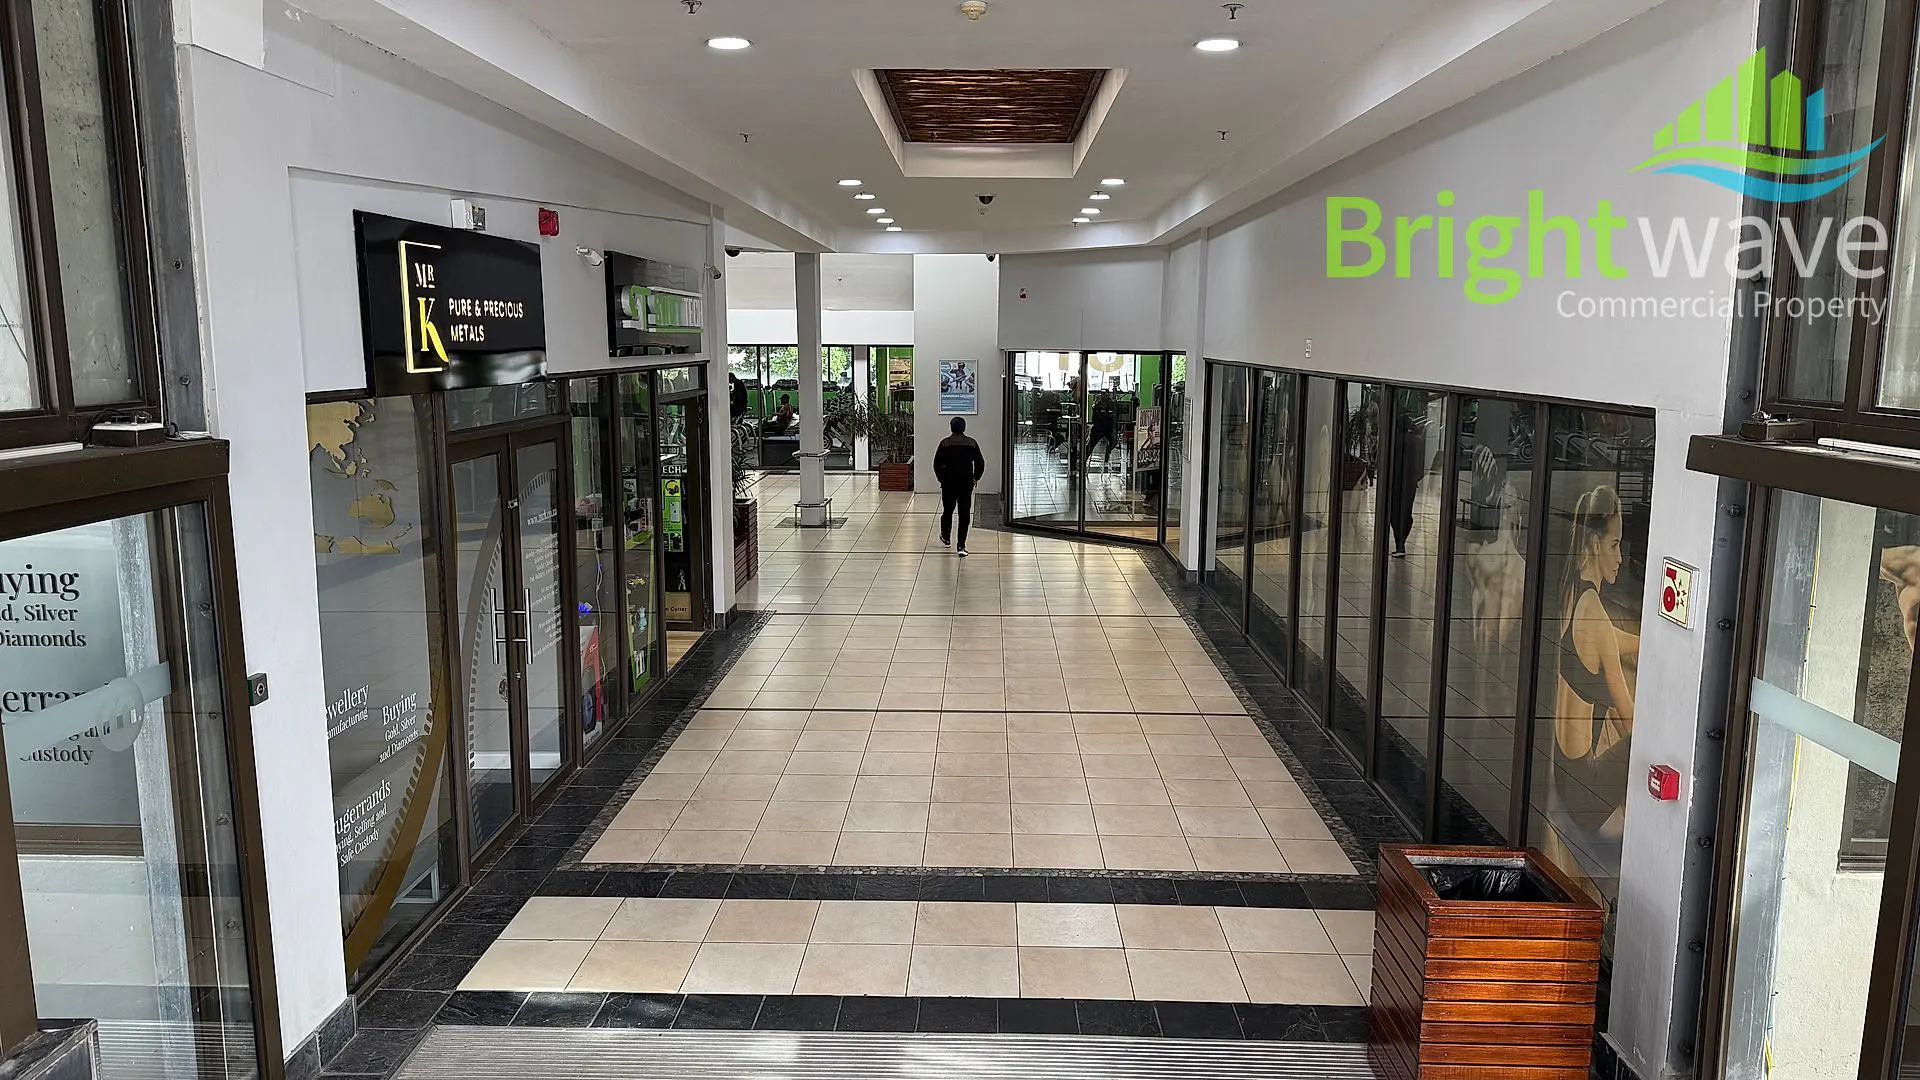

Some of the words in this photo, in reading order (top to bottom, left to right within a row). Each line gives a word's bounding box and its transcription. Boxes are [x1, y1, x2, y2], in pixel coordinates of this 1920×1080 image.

[448, 297, 472, 317] PURE
[474, 299, 482, 317] &
[483, 299, 524, 319] PRECIOUS
[416, 297, 449, 363] K
[450, 323, 485, 342] METALS
[662, 465, 681, 474] ECH
[24, 603, 78, 622] Silver
[326, 684, 369, 720] wellery
[382, 692, 417, 726] Buying
[327, 707, 369, 739] anufacturing
[385, 723, 400, 742] Gold,
[400, 715, 417, 732] Silver
[379, 745, 391, 763] and
[391, 727, 419, 755] Diamonds
[334, 779, 392, 835] ugerrands
[354, 814, 375, 838] Selling
[375, 803, 387, 821] and
[340, 848, 355, 867] Safe
[354, 828, 379, 855] Custody
